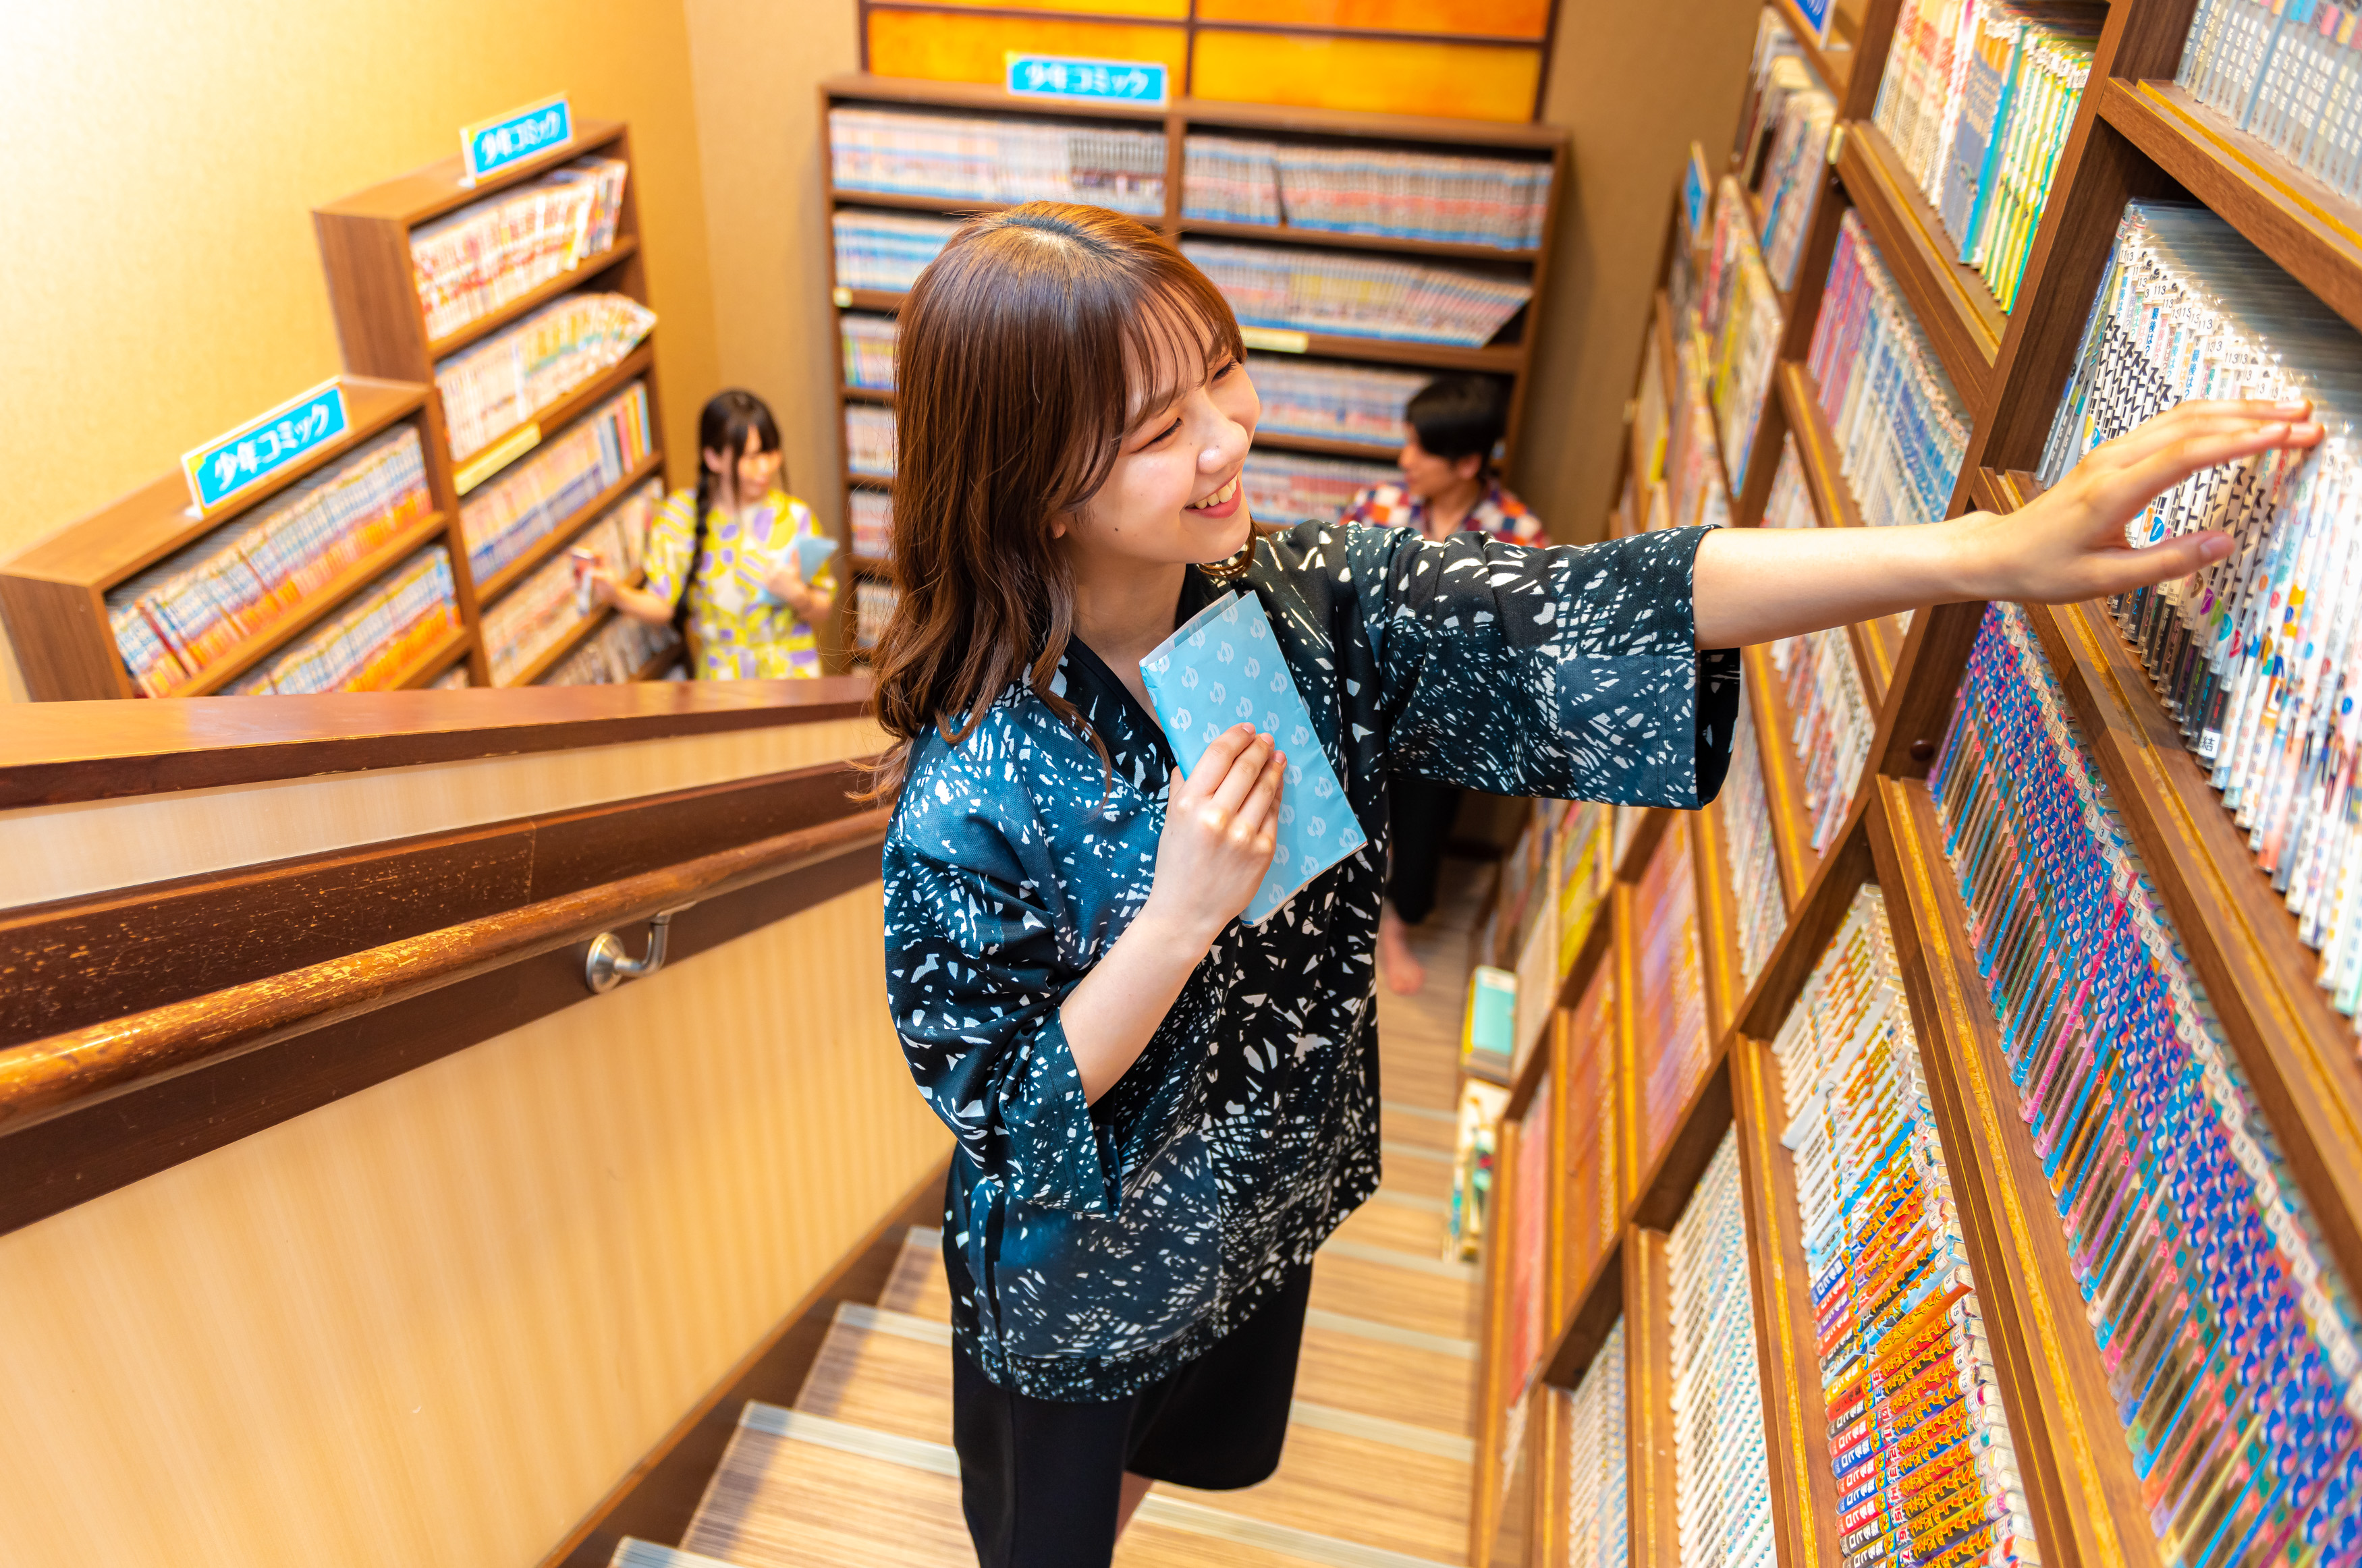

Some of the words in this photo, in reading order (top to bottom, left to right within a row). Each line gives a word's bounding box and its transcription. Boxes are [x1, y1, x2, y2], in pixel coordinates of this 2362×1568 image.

[2154, 285, 2166, 295] 113
[2163, 299, 2173, 308] 113
[2145, 308, 2160, 356] 最後は?
[2154, 319, 2168, 365] 最後は?
[2199, 319, 2213, 329] 113
[2089, 315, 2115, 414] ストレート!!
[2096, 325, 2120, 426] ストレート!!
[2166, 332, 2182, 382] 最後は?
[2184, 349, 2200, 401] 最後は?
[214, 404, 329, 491] 少年コミック
[2228, 488, 2266, 611] ストレート!!
[2200, 735, 2216, 752] 結
[1882, 1333, 1952, 1397] ベイブレードバースト
[1888, 1353, 1956, 1418] ベイブレードバースト
[1892, 1374, 1960, 1438] ベイブレードバースト
[1896, 1397, 1968, 1457] ベイブレードバースト
[1888, 1444, 1897, 1460] 12
[1888, 1463, 1898, 1480] 13
[1897, 1437, 1974, 1501] ベイブレードバースト
[1898, 1418, 1969, 1476] ベイブレードバースト
[1889, 1485, 1899, 1502] 14
[1894, 1505, 1902, 1523] 15
[1902, 1459, 1977, 1521] ベイブレードバースト
[1907, 1480, 1982, 1540] ベイブレードバースト
[1898, 1526, 1907, 1541] 16
